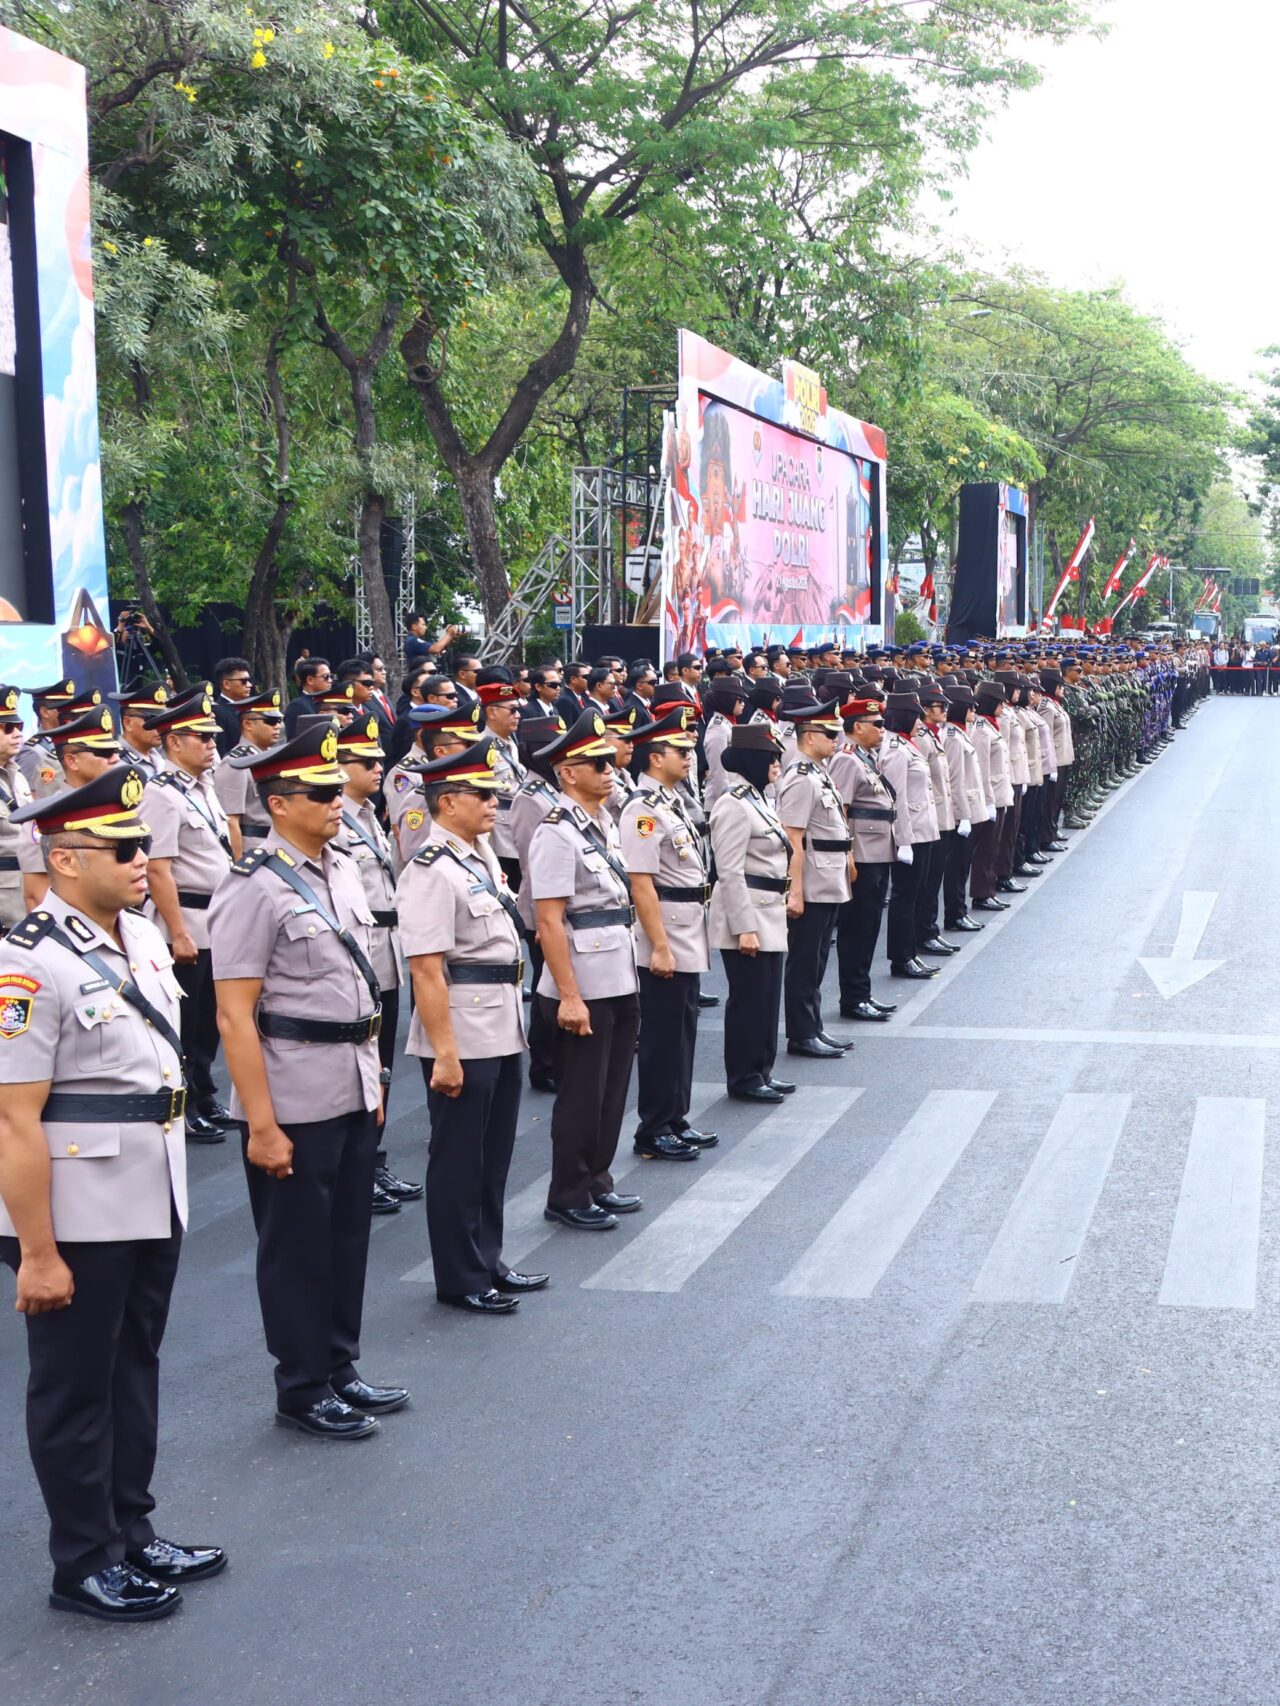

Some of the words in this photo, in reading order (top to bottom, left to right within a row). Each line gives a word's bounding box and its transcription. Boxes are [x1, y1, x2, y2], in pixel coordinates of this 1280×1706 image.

[794, 374, 820, 413] POLRI
[771, 450, 811, 492] UPACARA
[752, 478, 785, 525] HARI
[787, 487, 826, 534] JUANG
[773, 528, 809, 569] POLRI
[783, 575, 799, 591] Agustus
